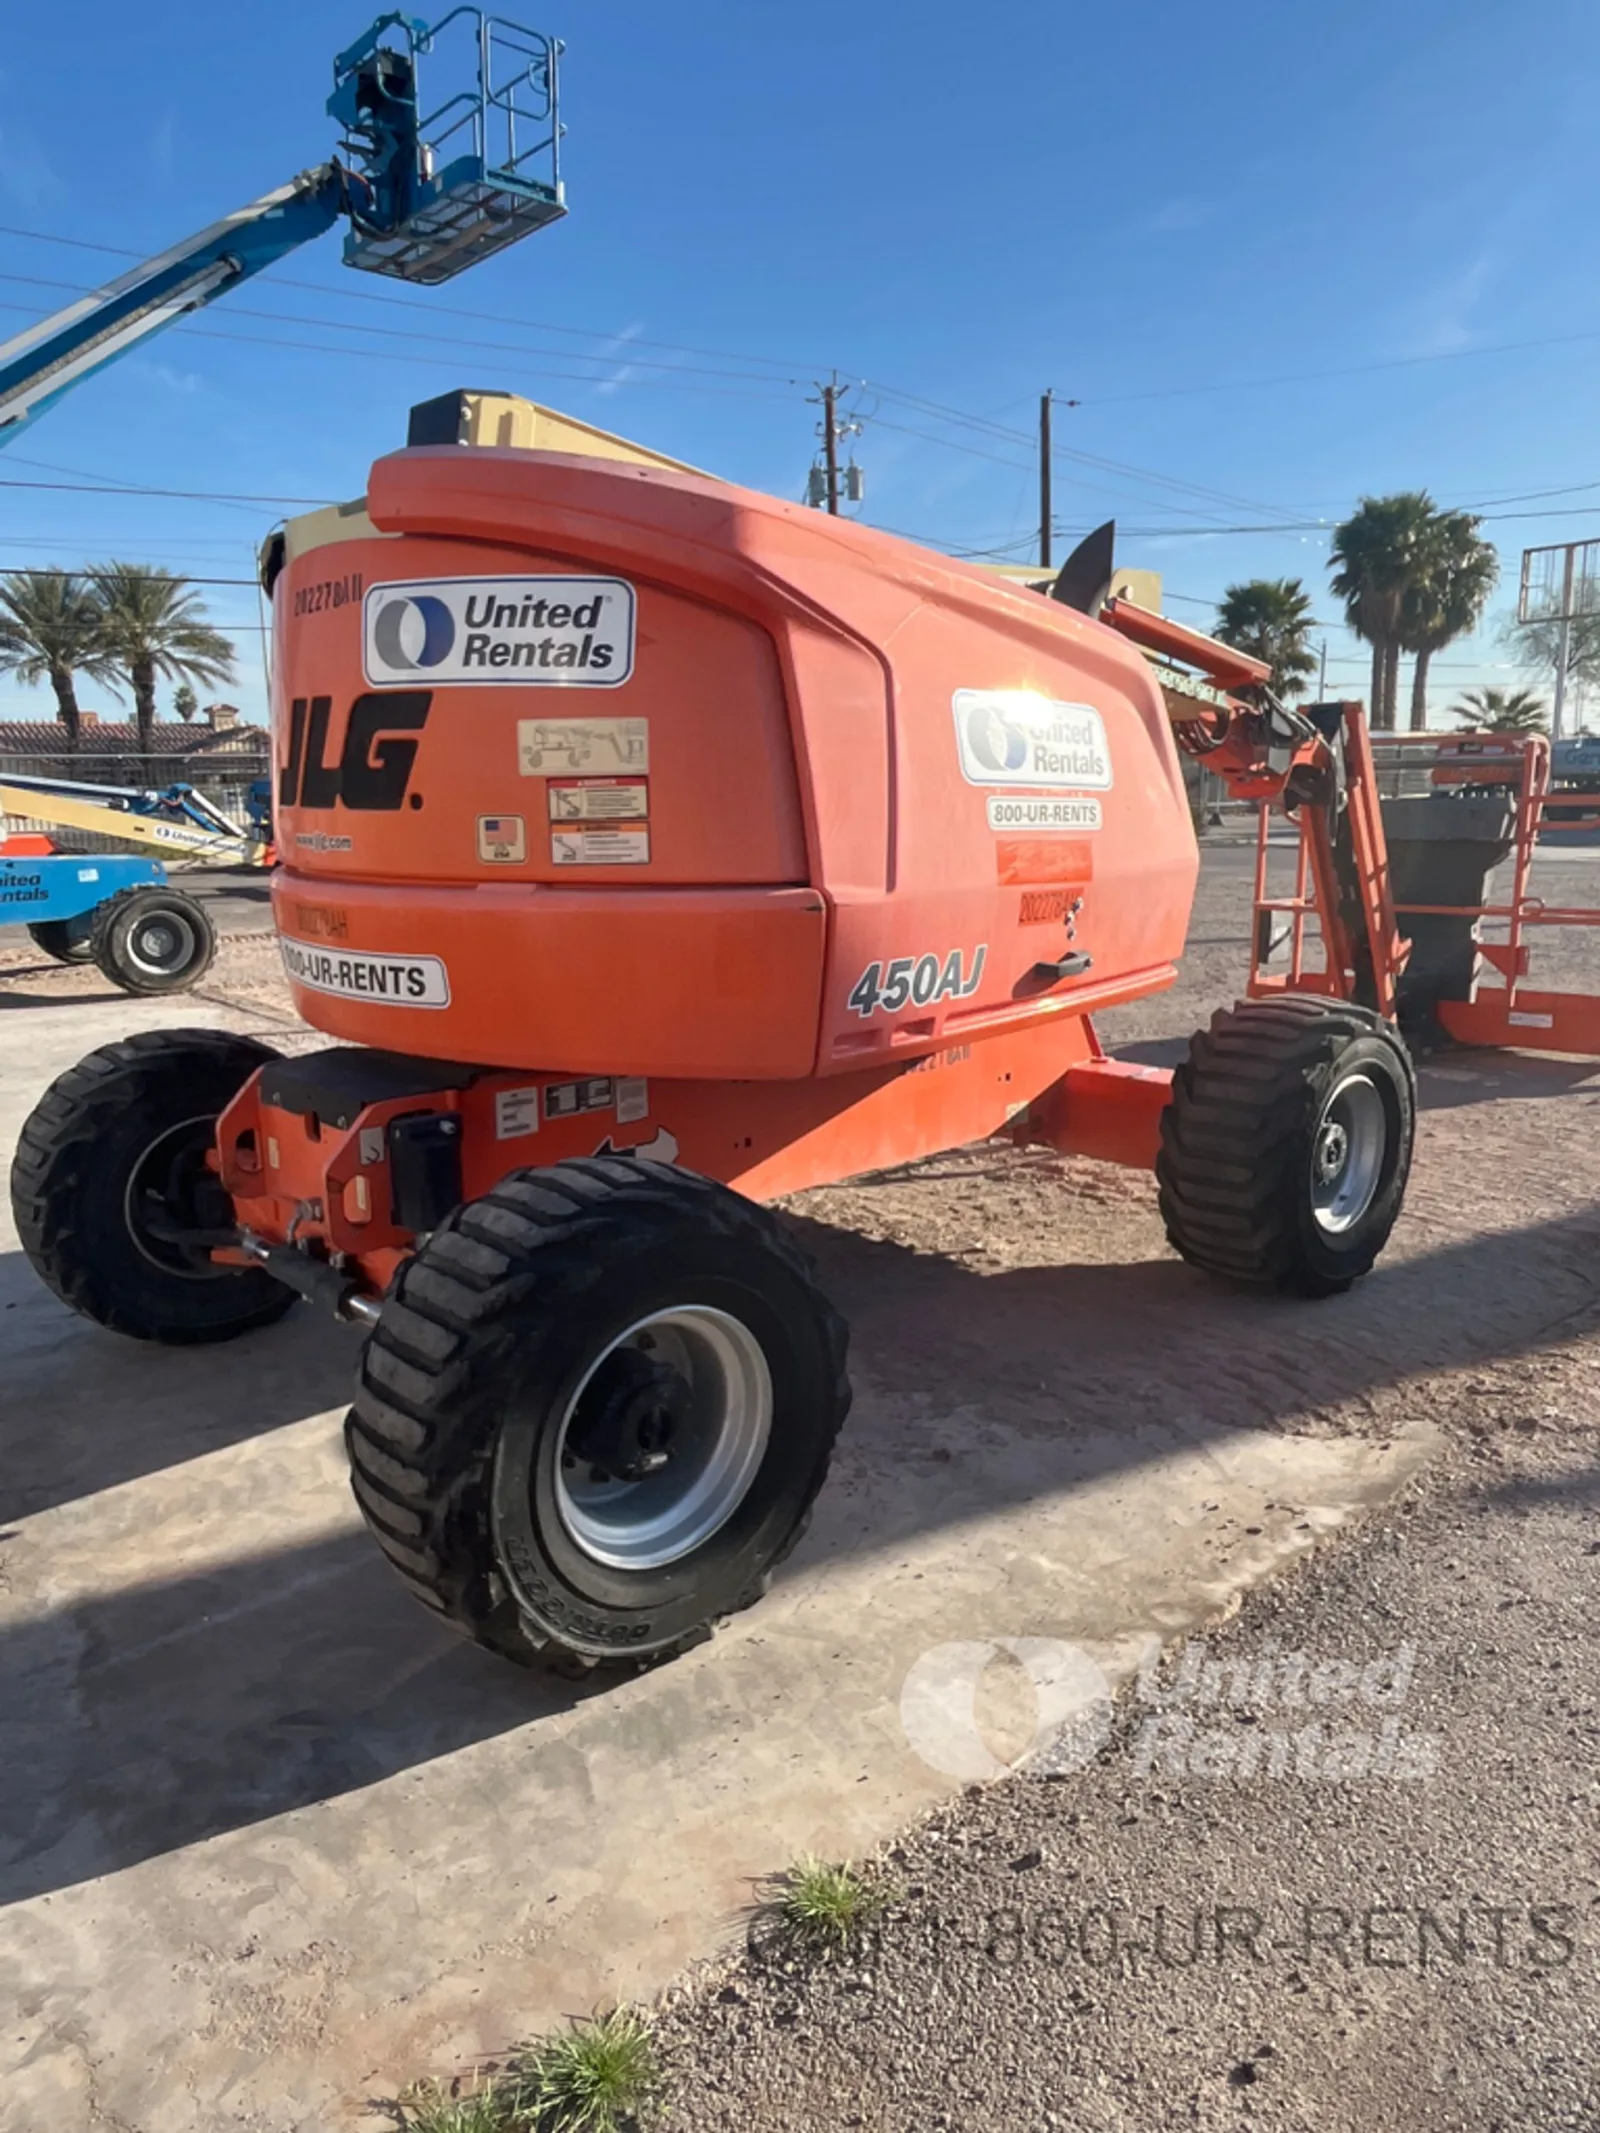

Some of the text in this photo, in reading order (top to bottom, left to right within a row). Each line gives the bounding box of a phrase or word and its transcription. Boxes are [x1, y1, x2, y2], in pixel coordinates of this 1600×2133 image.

[464, 595, 603, 629] United
[462, 633, 614, 669] Rentals
[1033, 744, 1105, 777] Rentals
[994, 804, 1097, 823] 800-UR-RENTS
[849, 945, 987, 1016] 450AJ
